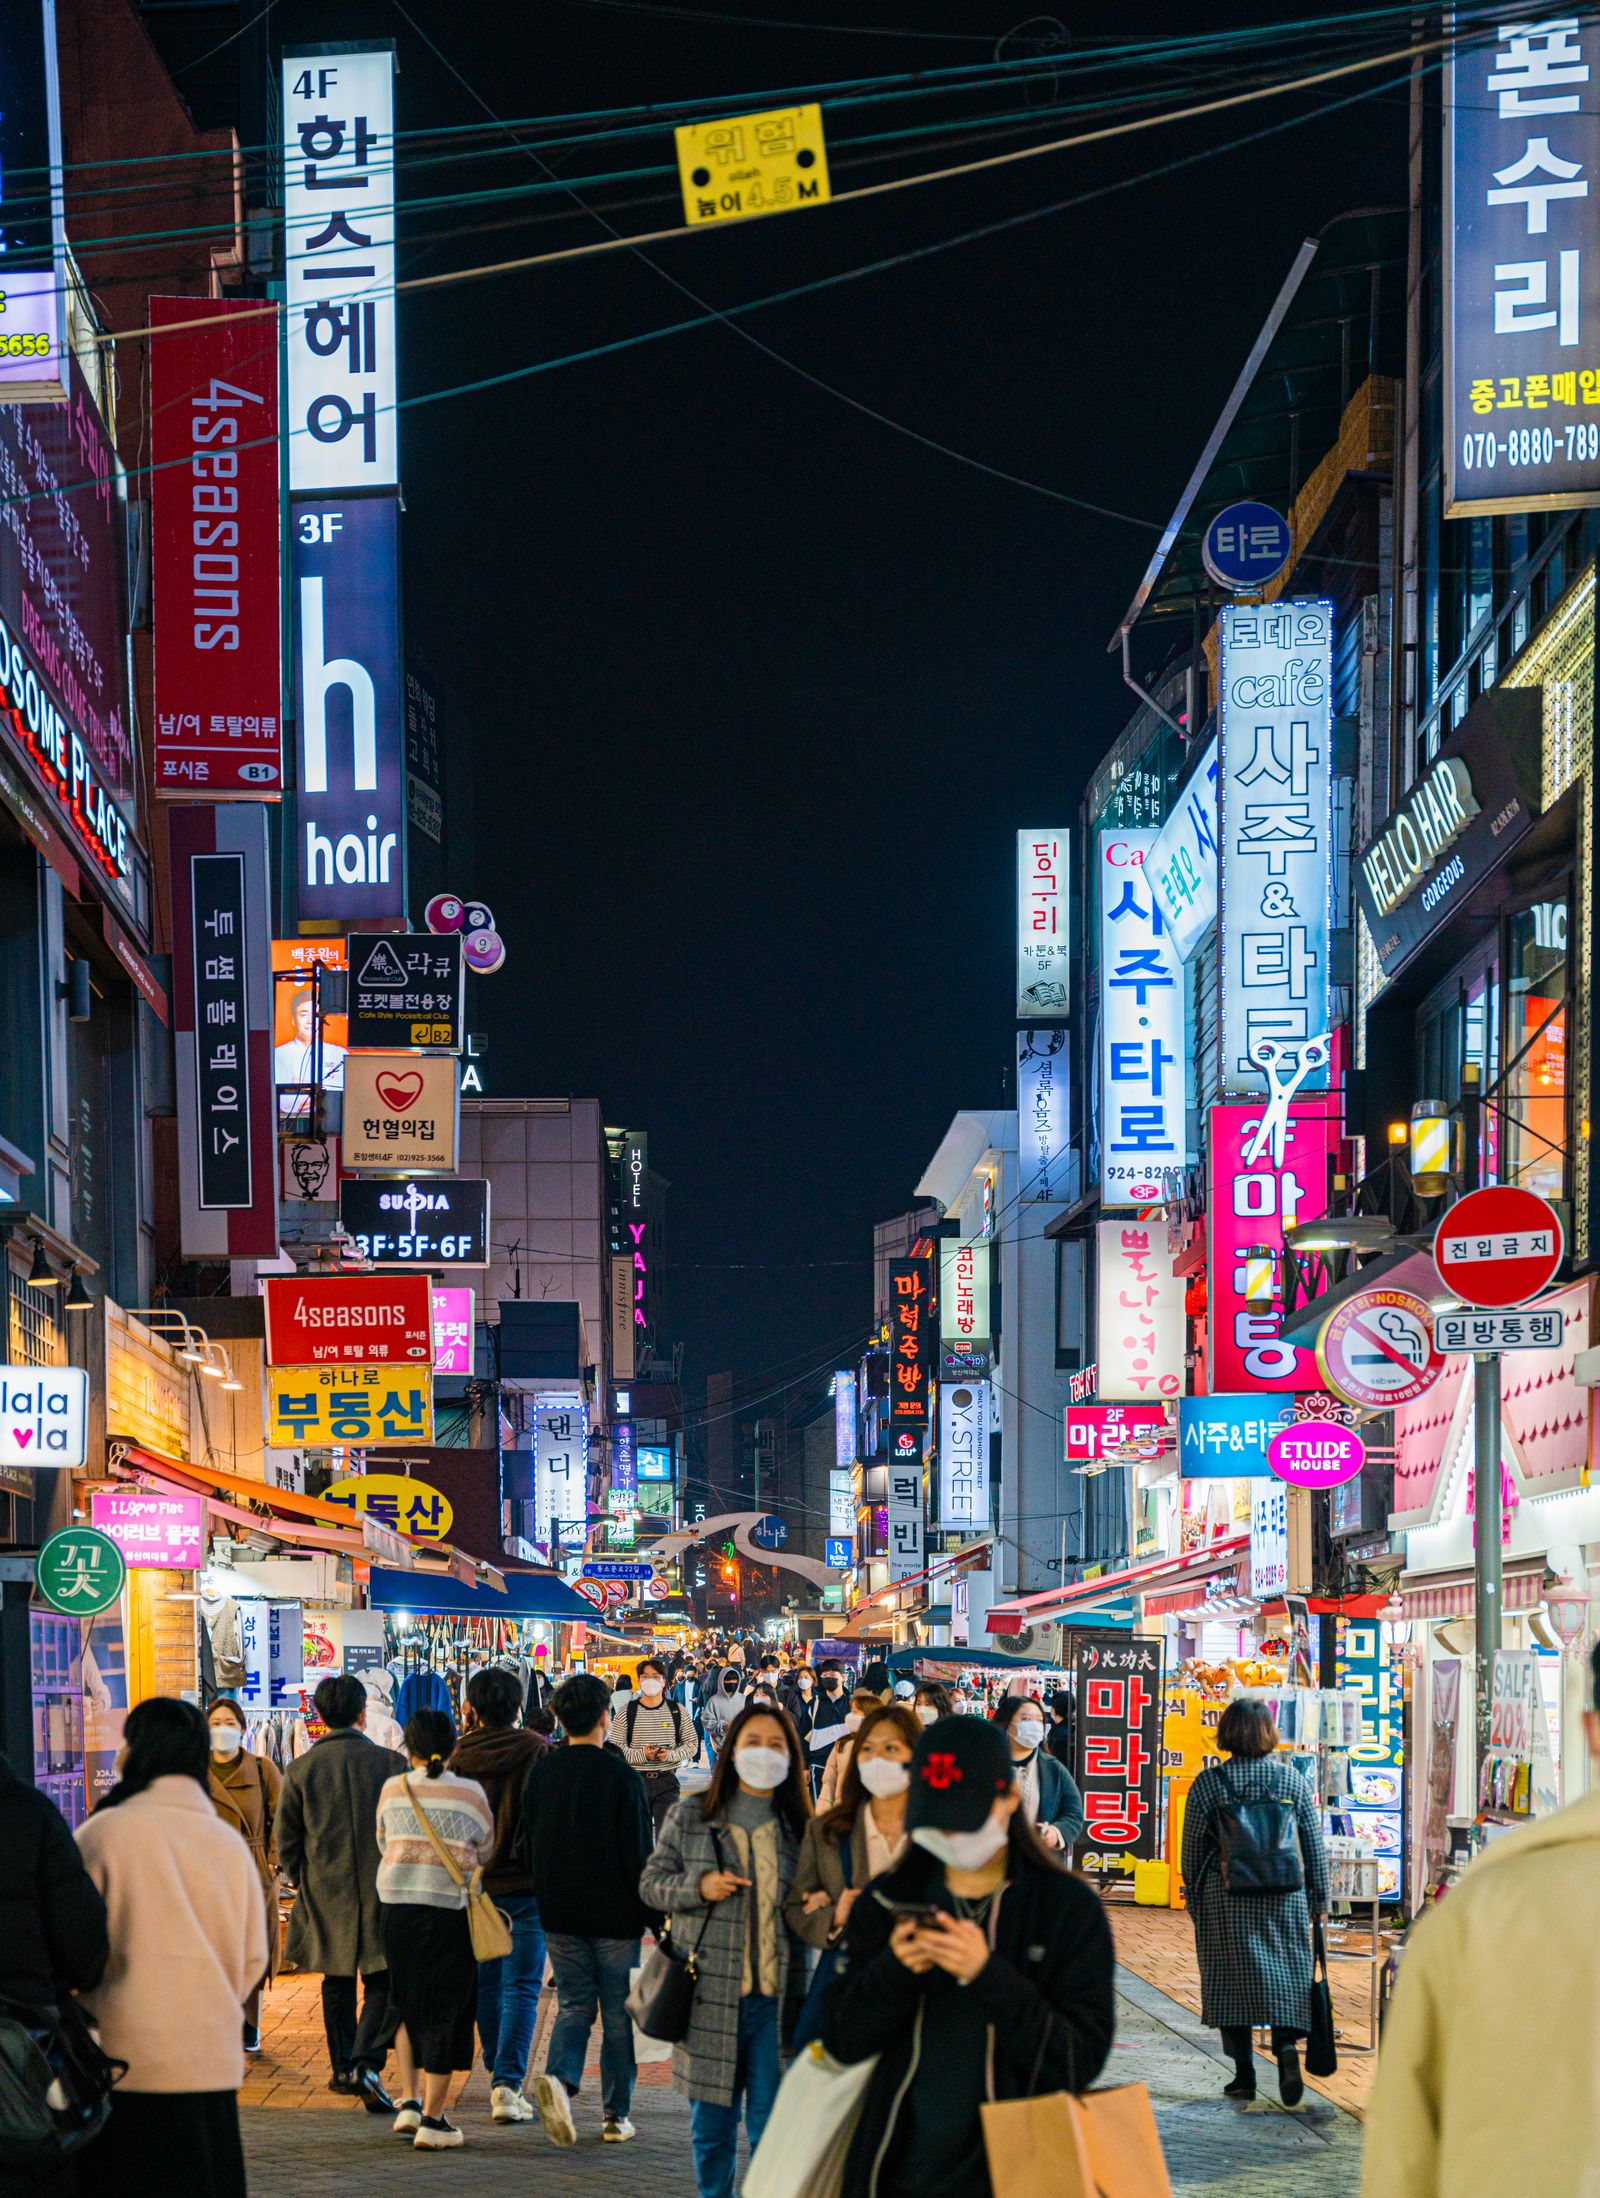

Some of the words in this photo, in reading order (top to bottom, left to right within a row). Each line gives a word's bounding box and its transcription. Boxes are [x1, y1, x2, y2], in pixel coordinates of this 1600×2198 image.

[292, 69, 337, 99] 4F
[706, 117, 796, 166] 위험
[297, 115, 377, 463] 한스헤어
[192, 379, 264, 650] 4seasons
[299, 514, 343, 543] 3F
[1217, 524, 1281, 561] 타로
[1229, 615, 1326, 649] 로데오
[300, 577, 377, 792] h
[1231, 659, 1324, 709] café
[159, 714, 200, 736] 남/여
[210, 715, 277, 738] 토탈의류
[163, 761, 209, 781] 포시즌
[248, 767, 269, 779] B1
[71, 732, 128, 876] PLACE
[306, 814, 396, 885] hair
[1362, 813, 1421, 917] HELLO
[1411, 760, 1466, 858] HAIR
[1421, 855, 1465, 912] GORGEOUS
[1038, 960, 1052, 971] 5F
[357, 994, 452, 1010] 포켓볼전용장
[434, 1031, 450, 1043] B2
[363, 1119, 435, 1141] 헌혈의집
[630, 1149, 642, 1207] HOTEL
[1134, 1186, 1154, 1199] 3F
[1037, 1189, 1053, 1201] 4F
[1452, 1235, 1547, 1259] 진입금지
[628, 1224, 647, 1328] YAJA
[957, 1246, 976, 1334] 코인노래방
[294, 1297, 405, 1328] 4seasons
[618, 1268, 627, 1330] innisfree
[405, 1331, 427, 1340] 포시즌
[1445, 1316, 1554, 1345] 일방통행
[313, 1345, 339, 1358] 남/여
[343, 1346, 364, 1358] 토탈
[368, 1345, 389, 1357] 의류
[319, 1370, 380, 1387] 하나로
[278, 1389, 427, 1439] 부동산
[1106, 1408, 1124, 1422] 2F
[37, 1418, 68, 1450] la
[546, 1414, 571, 1480] 댄디
[1280, 1442, 1351, 1458] ETUDE
[1290, 1460, 1340, 1471] HOUSE
[159, 1502, 184, 1515] Flat
[755, 1517, 788, 1547] 하나로
[834, 1541, 844, 1555] R
[53, 1544, 108, 1598] 꽃
[244, 1617, 256, 1650] 상가
[1491, 1703, 1527, 1750] 20%
[1084, 1675, 1151, 1844] 마라탕
[1083, 1852, 1121, 1873] 2F
